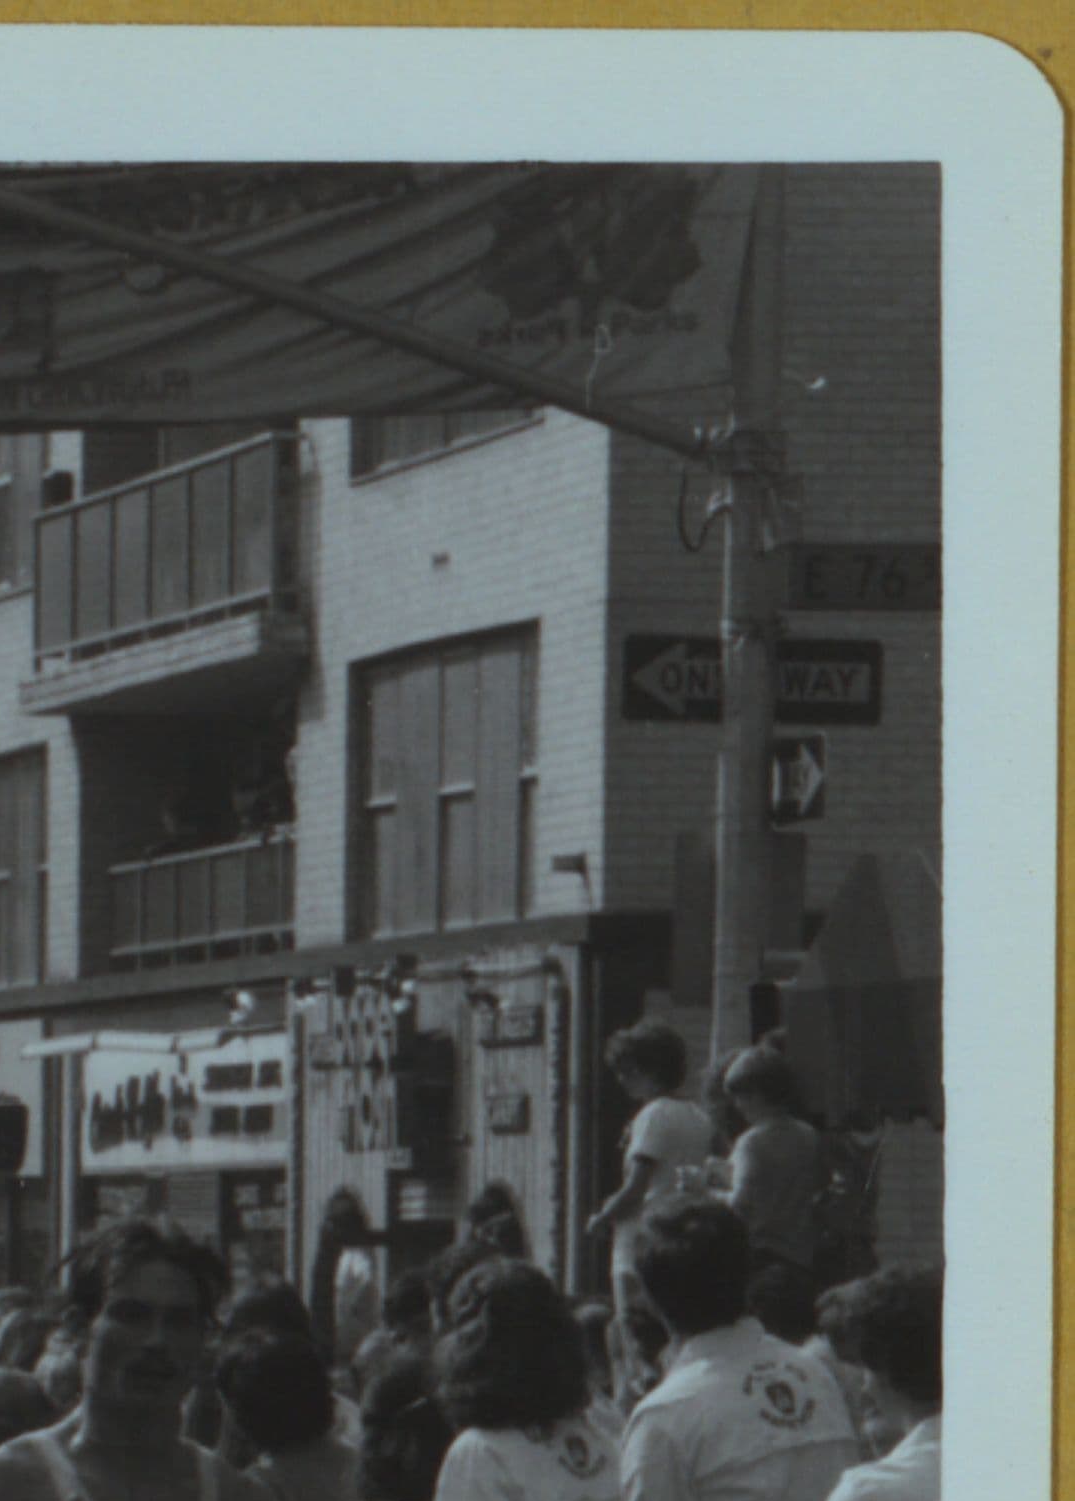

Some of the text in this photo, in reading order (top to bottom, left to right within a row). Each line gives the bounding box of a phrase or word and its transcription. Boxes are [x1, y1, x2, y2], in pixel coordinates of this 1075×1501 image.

[805, 554, 828, 599] E
[852, 554, 909, 600] 76
[660, 661, 859, 698] ON WAY
